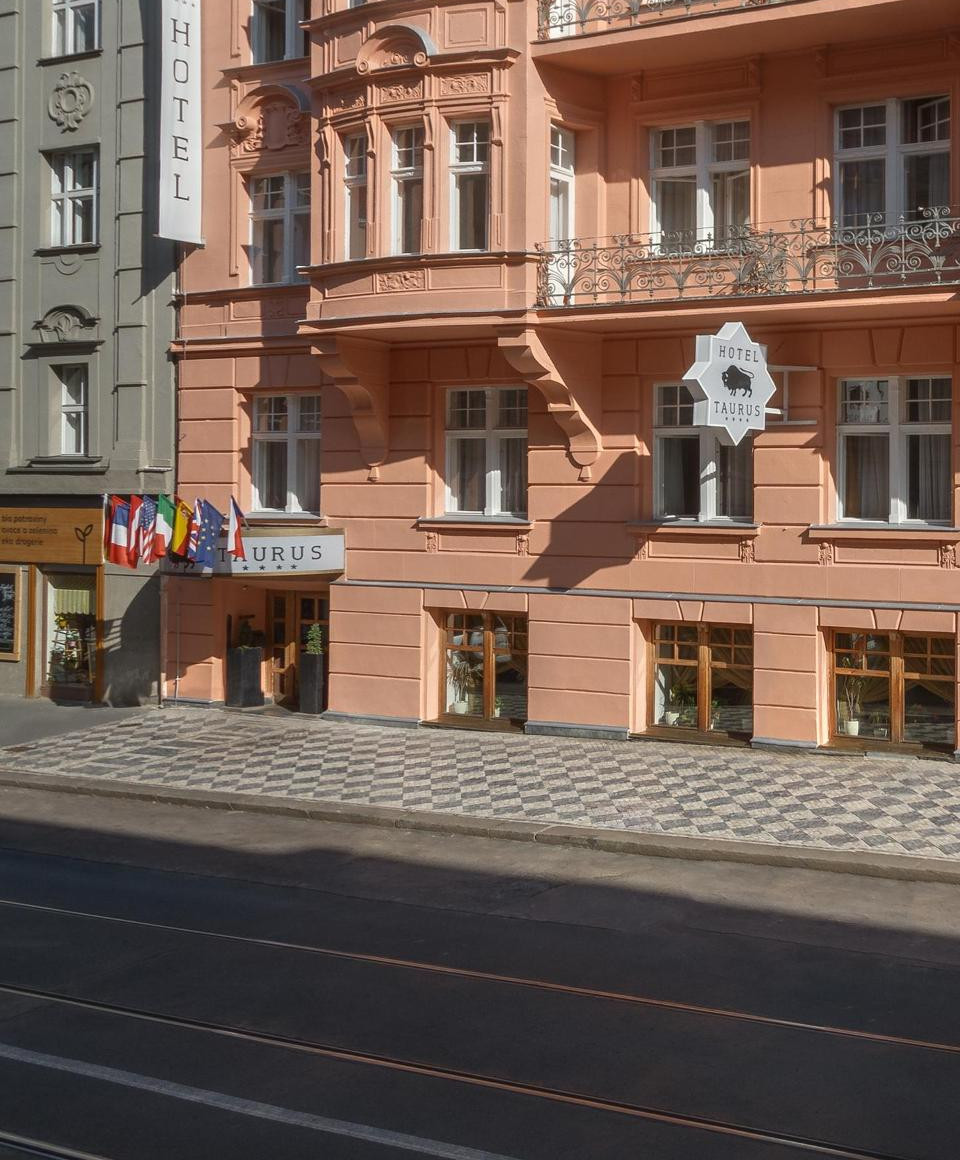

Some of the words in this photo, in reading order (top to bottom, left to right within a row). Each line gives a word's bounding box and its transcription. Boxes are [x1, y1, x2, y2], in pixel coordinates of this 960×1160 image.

[170, 17, 191, 202] HOTEL
[719, 345, 759, 363] HOTEL
[714, 401, 761, 417] TAURUS
